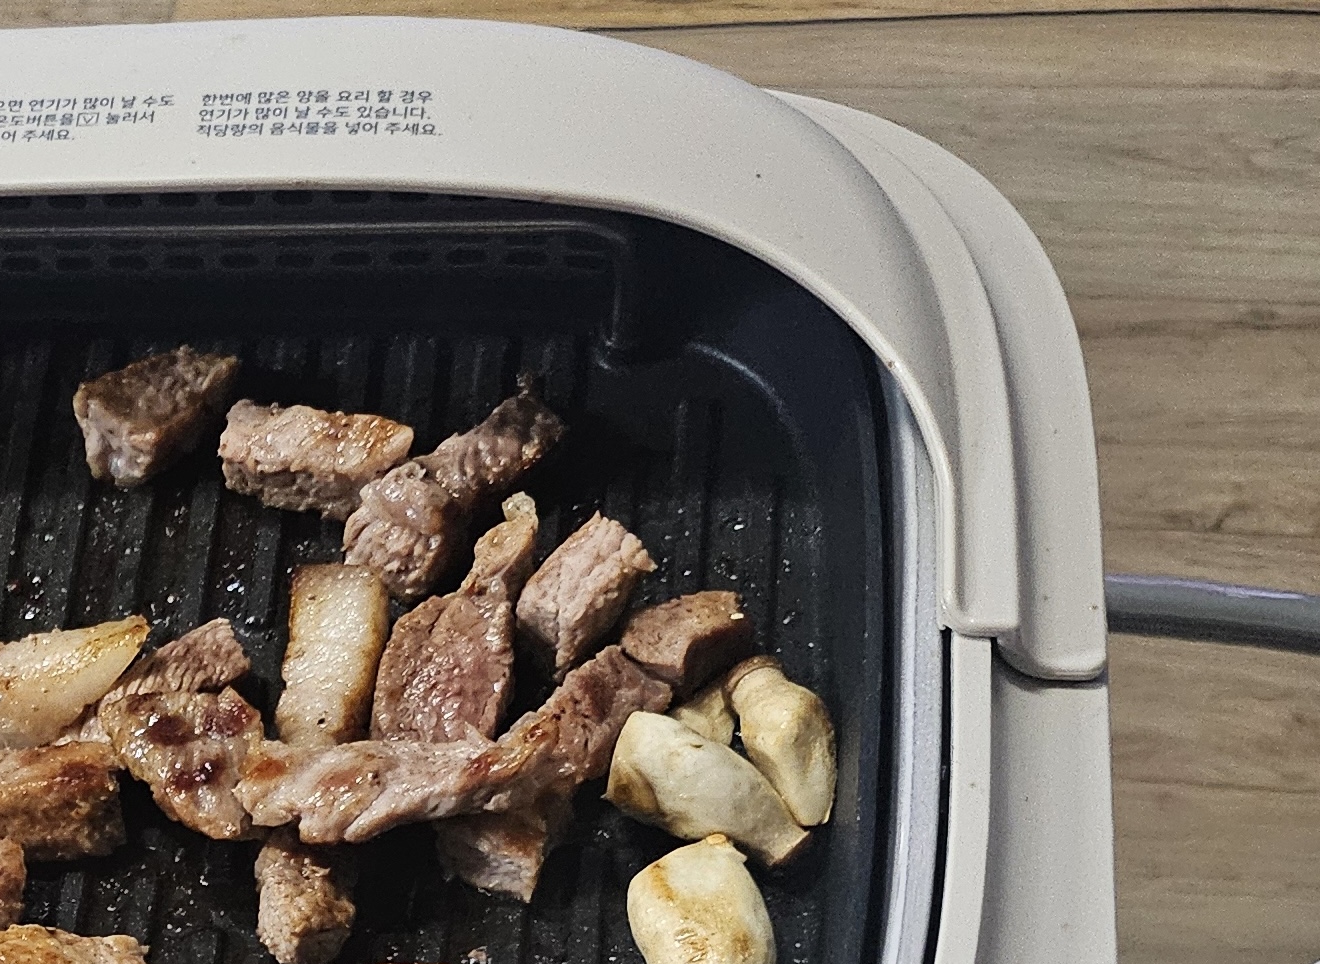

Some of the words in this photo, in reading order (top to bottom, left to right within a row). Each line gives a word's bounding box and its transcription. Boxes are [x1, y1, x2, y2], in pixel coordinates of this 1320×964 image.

[29, 98, 77, 112] 연기가
[83, 96, 115, 110] 많이
[121, 95, 137, 109] 날
[142, 94, 175, 107] 수도
[202, 92, 252, 107] 한번에
[257, 91, 291, 104] 많은
[296, 90, 331, 104] 양을
[336, 90, 370, 103] 요리
[377, 90, 393, 103] 할
[399, 90, 433, 104] 경우
[106, 110, 155, 124] 눌러서
[199, 106, 249, 122] 연기가
[255, 106, 288, 121] 많이
[295, 106, 311, 119] 날
[316, 106, 351, 119] 수도
[357, 106, 431, 120] 있습니다.
[22, 128, 75, 142] 주세요.
[196, 122, 264, 138] 적당량의
[270, 121, 338, 136] 음식물을
[345, 121, 379, 135] 넣어
[384, 122, 443, 136] 주세요.
